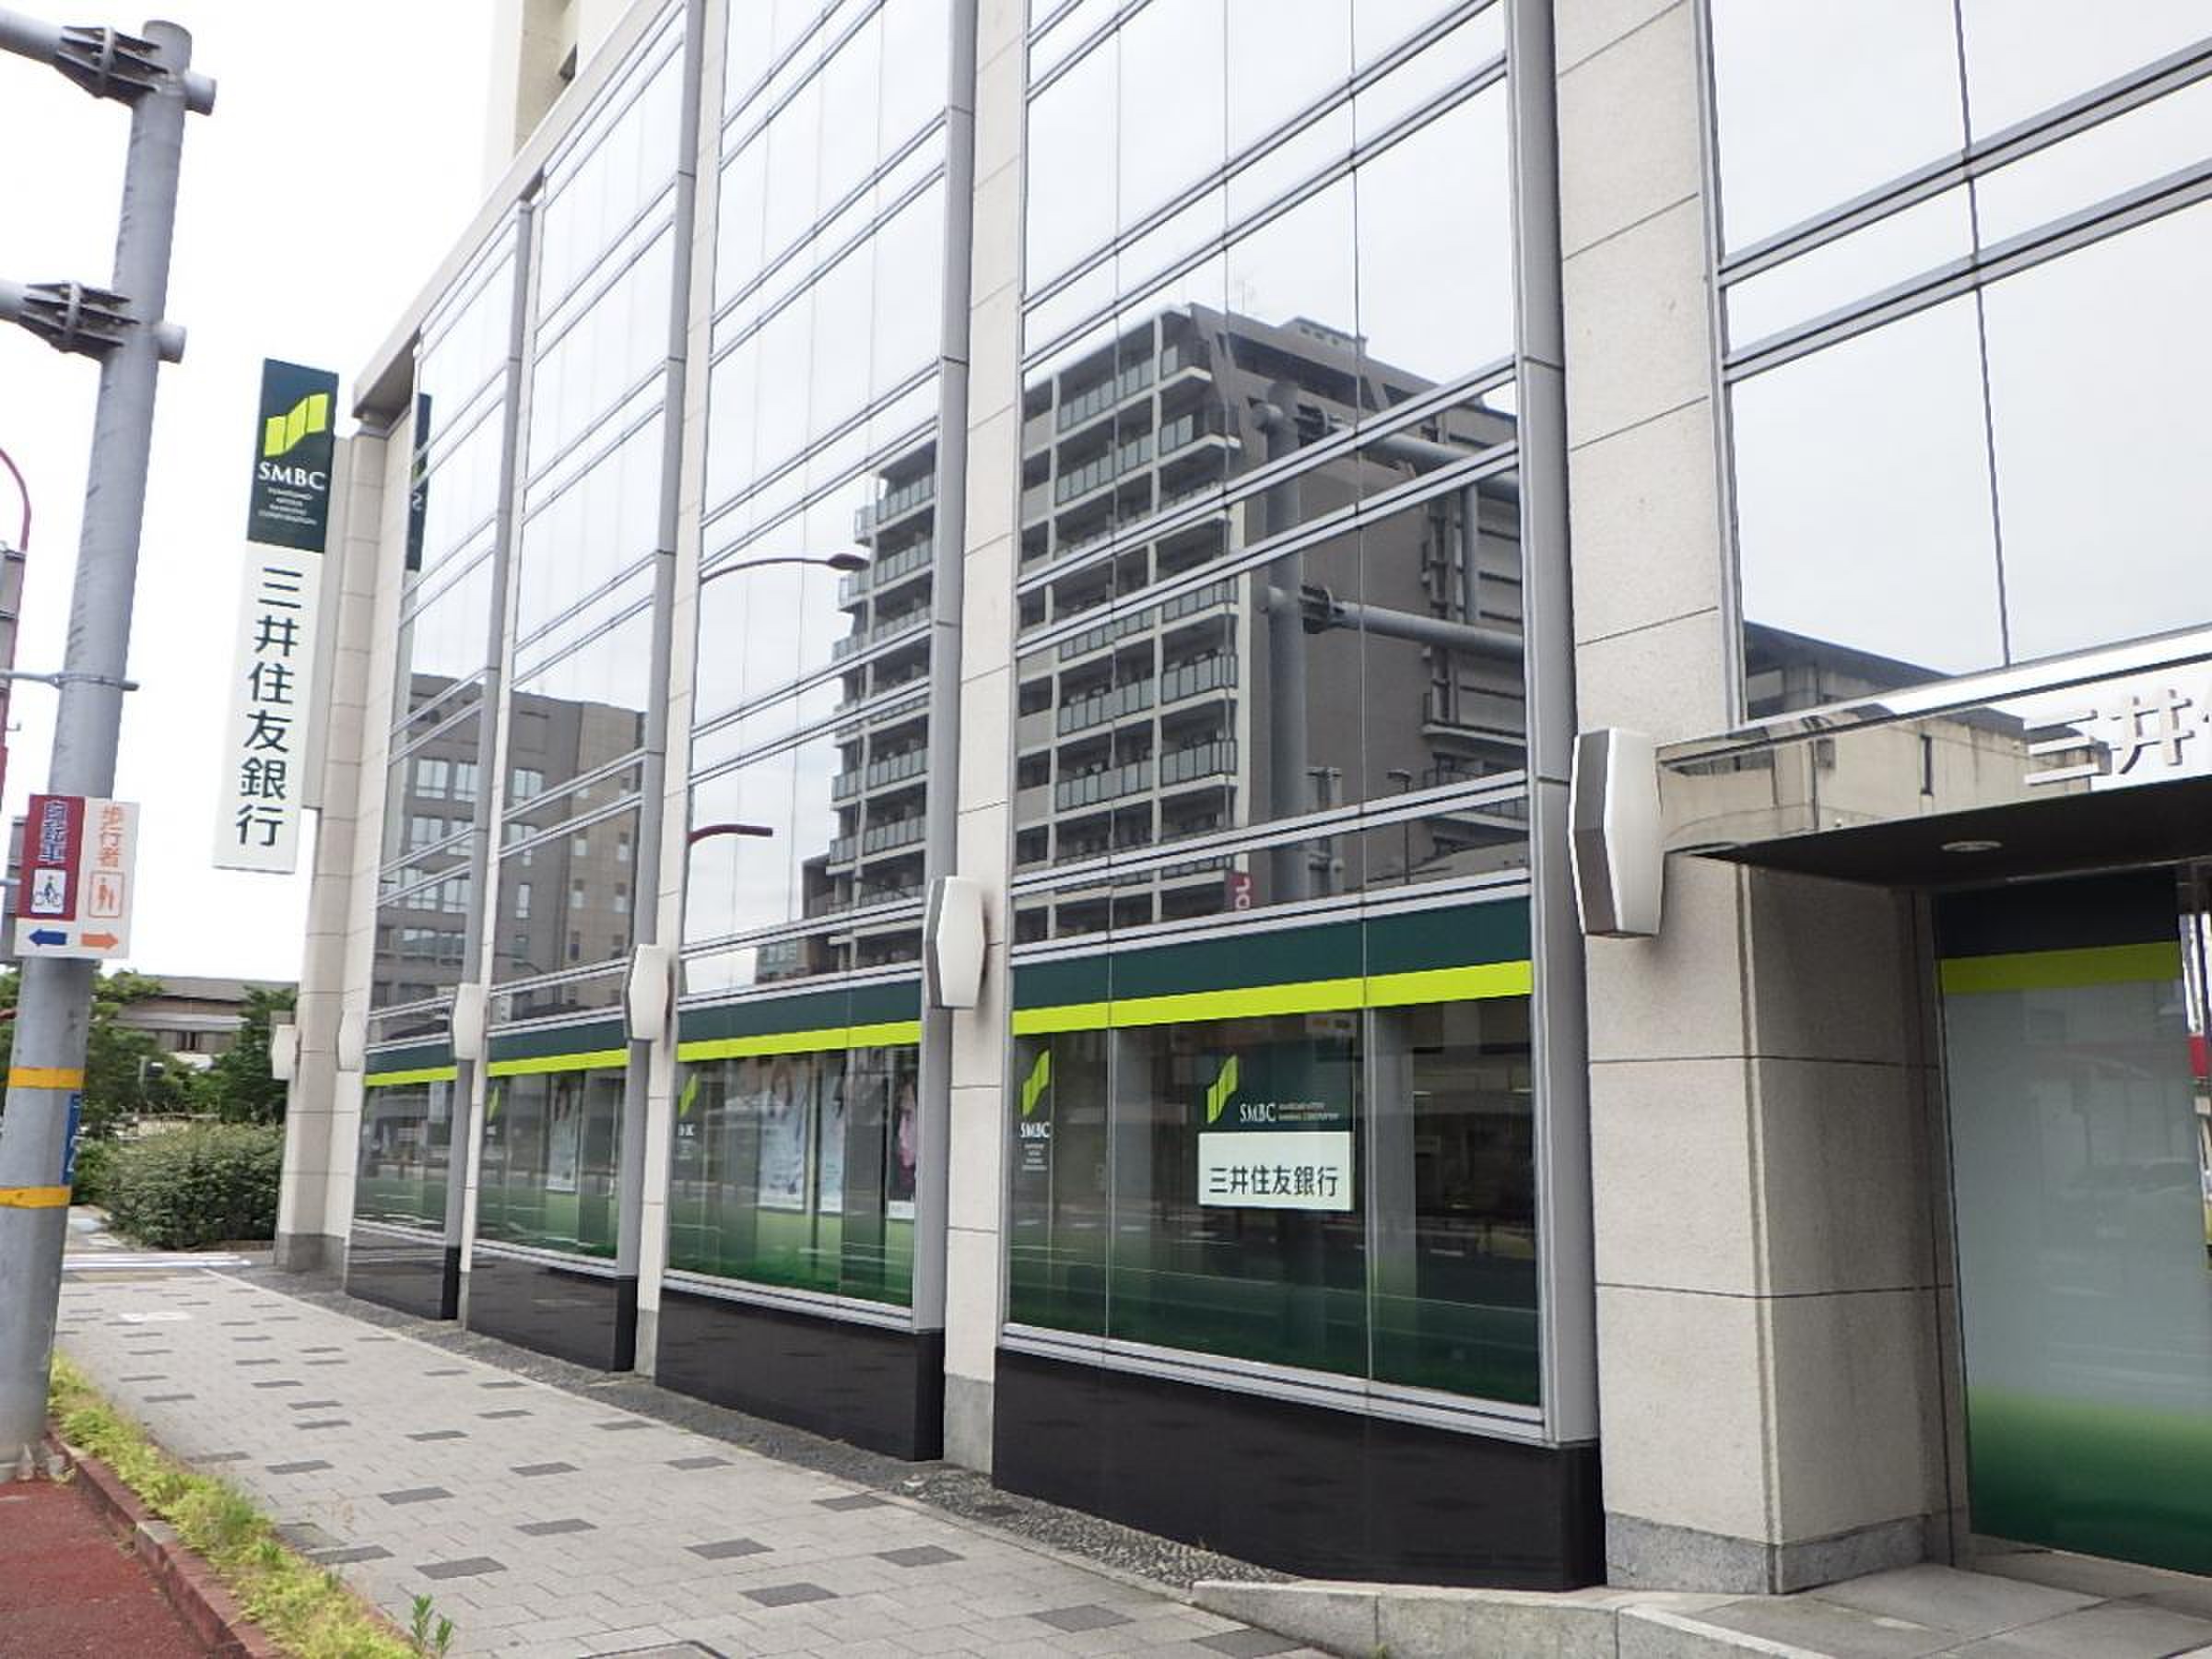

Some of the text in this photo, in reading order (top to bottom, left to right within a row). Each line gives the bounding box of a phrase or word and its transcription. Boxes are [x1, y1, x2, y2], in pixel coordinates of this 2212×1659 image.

[258, 461, 327, 491] SMBC
[235, 566, 303, 847] 三井住友銀行
[2023, 686, 2212, 786] 三井
[1239, 1102, 1277, 1123] SMBC
[1020, 1122, 1051, 1138] SMBC
[1208, 1164, 1338, 1197] 三井住友銀行
